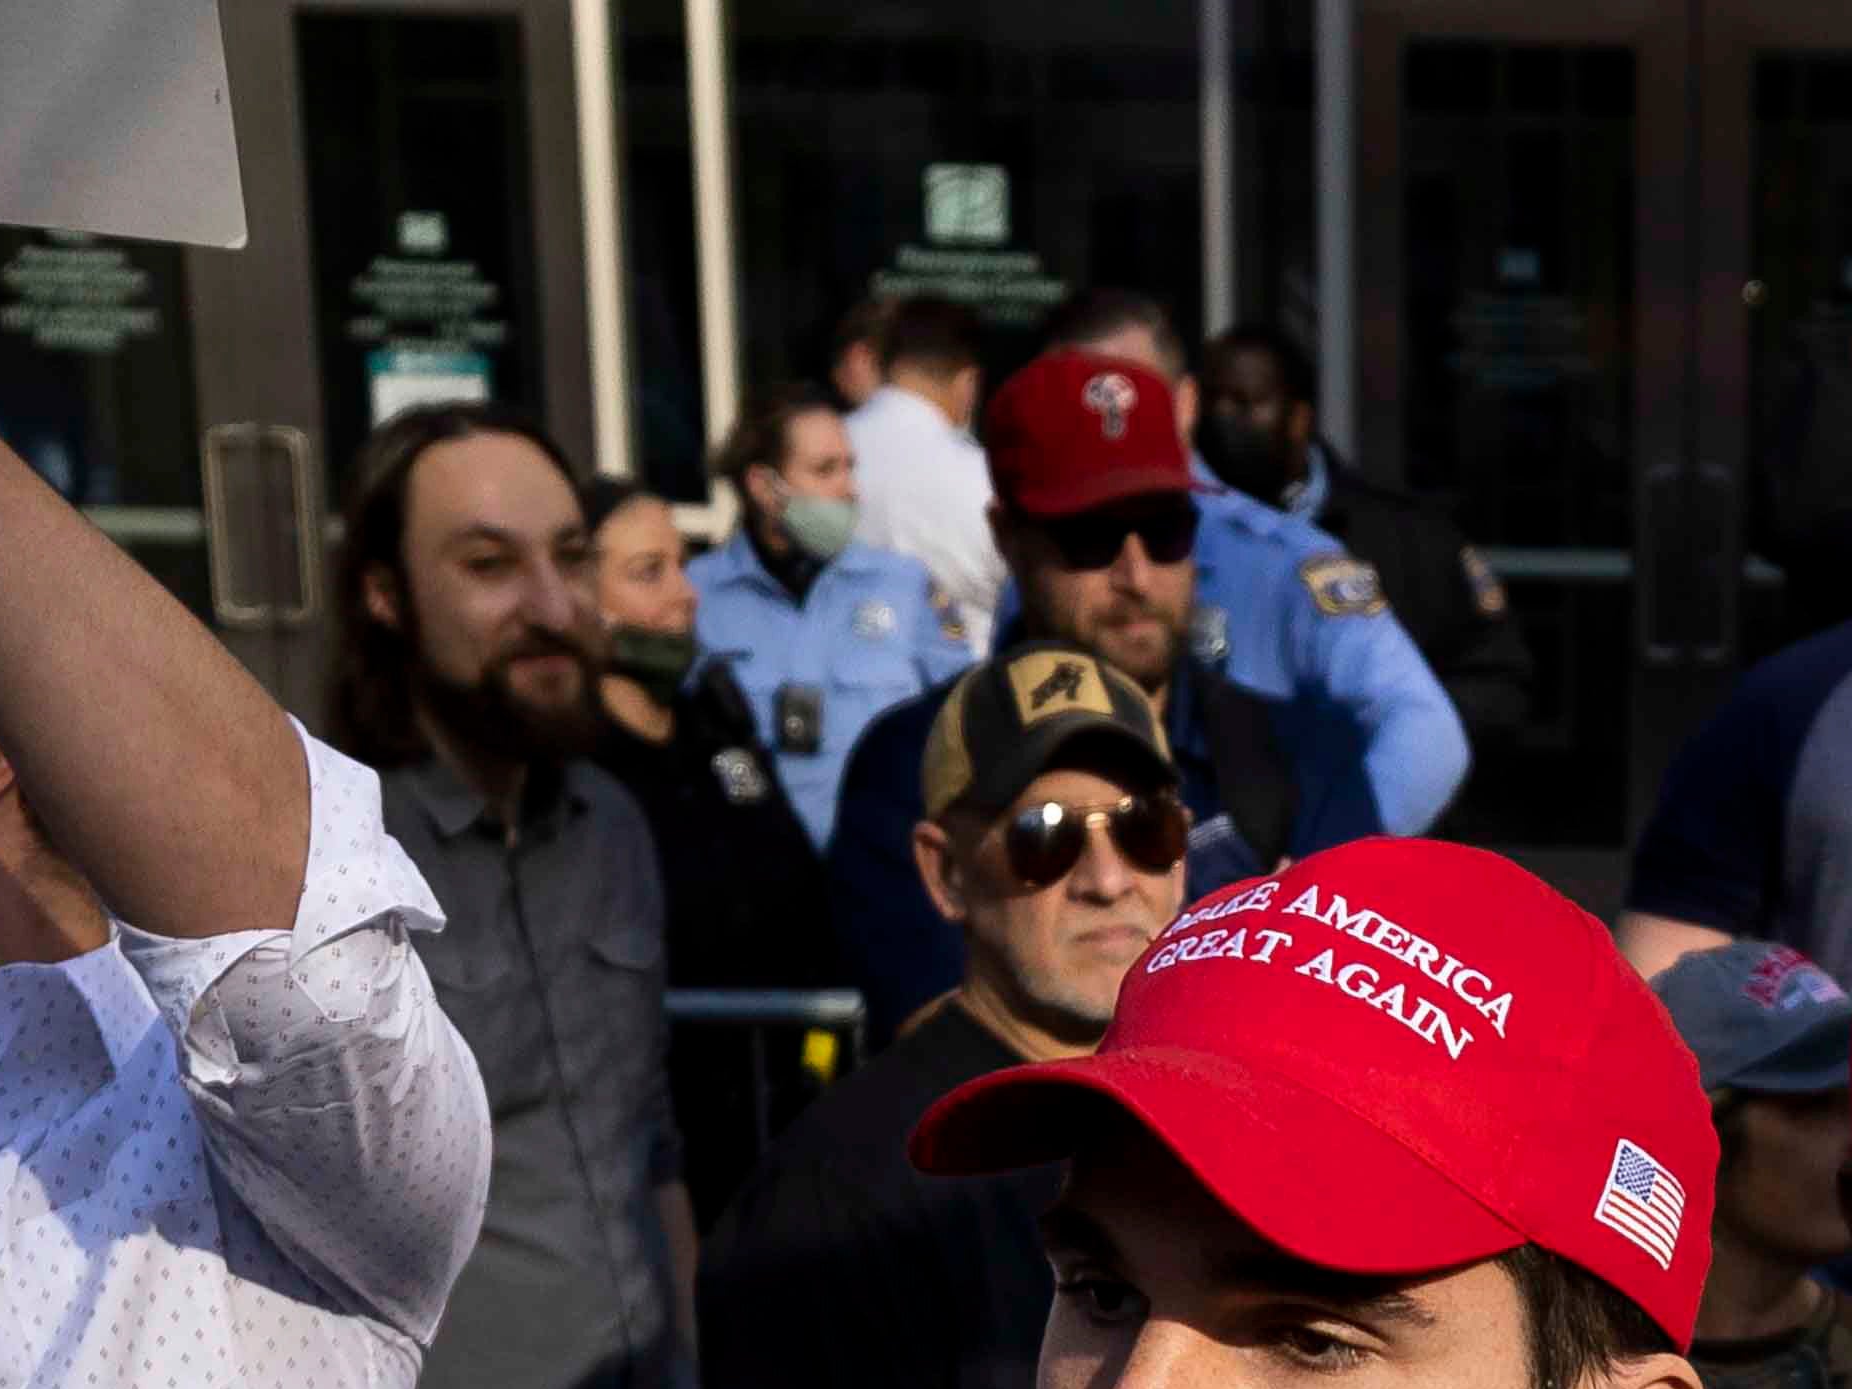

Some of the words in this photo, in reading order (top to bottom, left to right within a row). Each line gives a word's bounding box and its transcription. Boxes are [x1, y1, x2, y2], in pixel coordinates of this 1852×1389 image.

[1146, 927, 1293, 974] GREAT
[1294, 948, 1475, 1060] AGAIN
[1163, 880, 1281, 939] MAKE
[1281, 884, 1515, 1040] AMERICA
